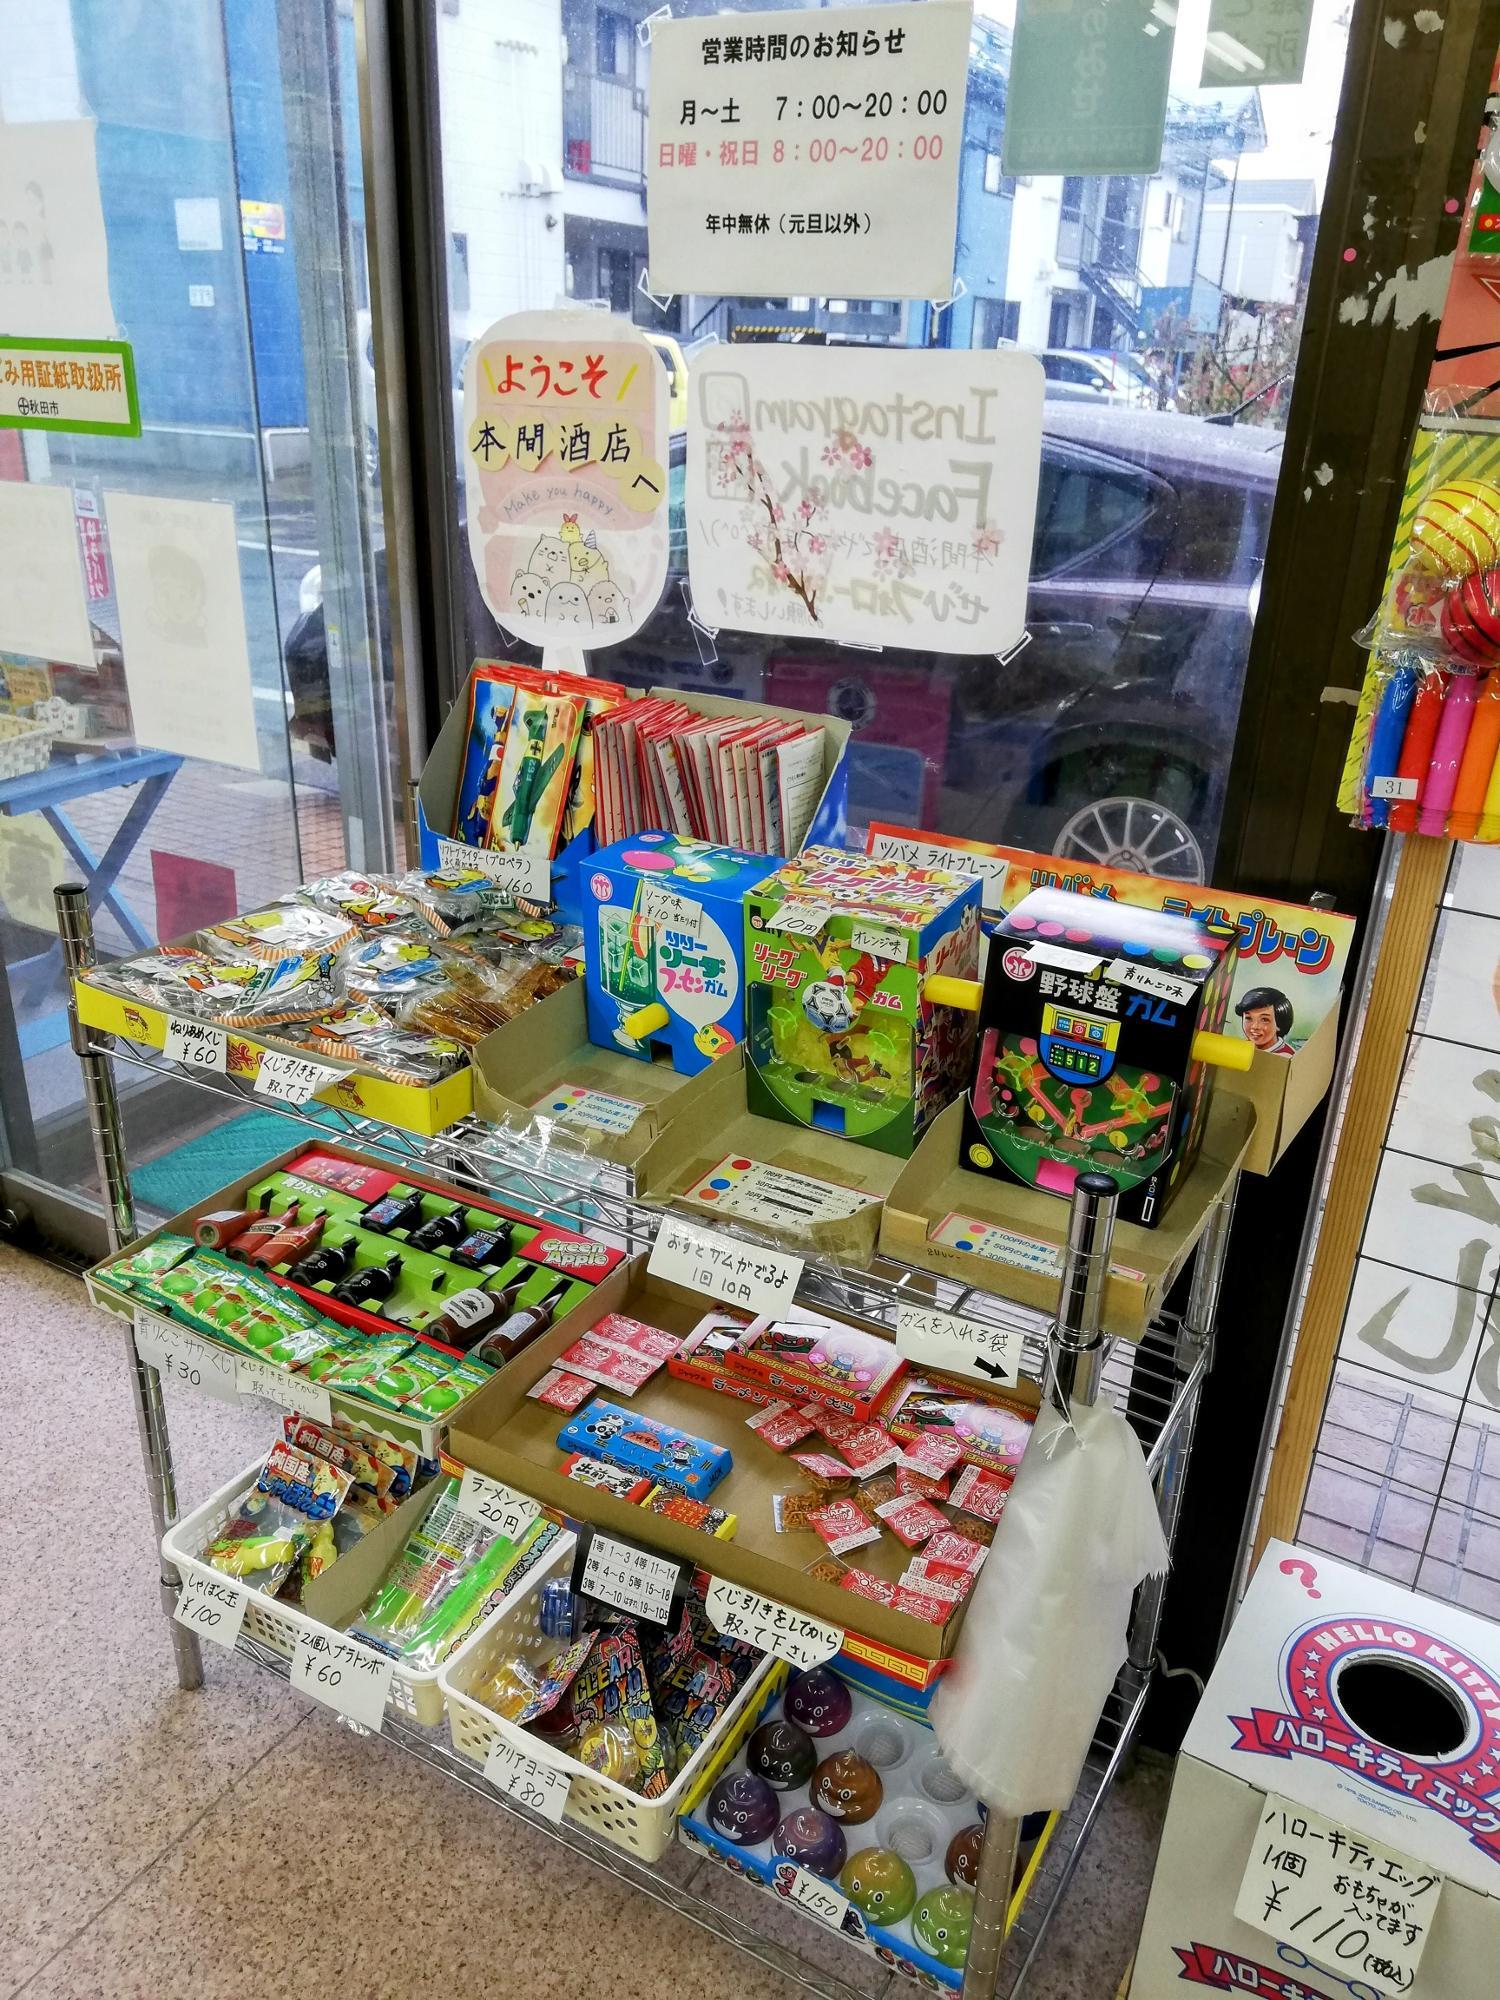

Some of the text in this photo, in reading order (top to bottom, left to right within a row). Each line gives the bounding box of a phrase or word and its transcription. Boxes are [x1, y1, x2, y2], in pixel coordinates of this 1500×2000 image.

[701, 27, 906, 66] 営業時間のお知らせ
[658, 140, 759, 168] 日曜・祝日
[0, 359, 122, 392] み用証紙取扱所
[497, 354, 608, 399] ようこそ
[29, 400, 59, 416] 秋田市
[472, 420, 631, 462] 本間酒店
[504, 487, 540, 521] Make
[547, 486, 568, 498] you
[1385, 781, 1402, 795] 31
[881, 842, 919, 861] ツバメ
[646, 889, 682, 910] ソーダ味
[776, 916, 817, 935] 10円
[754, 941, 800, 968] リーグ
[854, 931, 902, 956] オレンジ味
[659, 946, 726, 978] ソーダ
[761, 961, 808, 988] リーグ
[872, 990, 903, 1010] ガム
[1039, 970, 1122, 1013] 野球盤
[182, 1042, 217, 1064] ¥60
[540, 1239, 606, 1257] Green
[544, 1250, 609, 1268] Apple
[721, 1278, 751, 1301] 10円
[900, 1311, 1009, 1357] ガムを入れる袋
[164, 1352, 201, 1386] ¥30
[300, 1429, 347, 1468] 純国産
[268, 1450, 312, 1484] 純国産
[472, 1476, 538, 1518] ラーメンくじ
[478, 1502, 518, 1535] 20円
[592, 1539, 605, 1553] 1等
[634, 1555, 648, 1570] 4等
[187, 1573, 238, 1607] しゃぼん玉
[582, 1577, 596, 1592] 3等
[587, 1558, 601, 1572] 2等
[628, 1576, 642, 1590] 5等
[180, 1597, 222, 1627] ¥100
[713, 1586, 837, 1651] くじ引きをしてから
[723, 1612, 817, 1664] 取って下さい
[1313, 1624, 1418, 1652] HELLO
[304, 1655, 343, 1687] ¥60
[574, 1644, 634, 1706] CLEAR
[593, 1666, 643, 1721] YOYO
[494, 1743, 571, 1790] クリアヨーヨー
[1274, 1719, 1422, 1791] ハローキティ
[507, 1774, 545, 1807] ¥80
[1263, 1844, 1307, 1878] 1個
[1265, 1810, 1441, 1898] ハローキティ エッグ
[798, 1880, 839, 1916] ¥150
[1333, 1874, 1413, 1920] おもちゃが
[1264, 1880, 1370, 1960] ¥110
